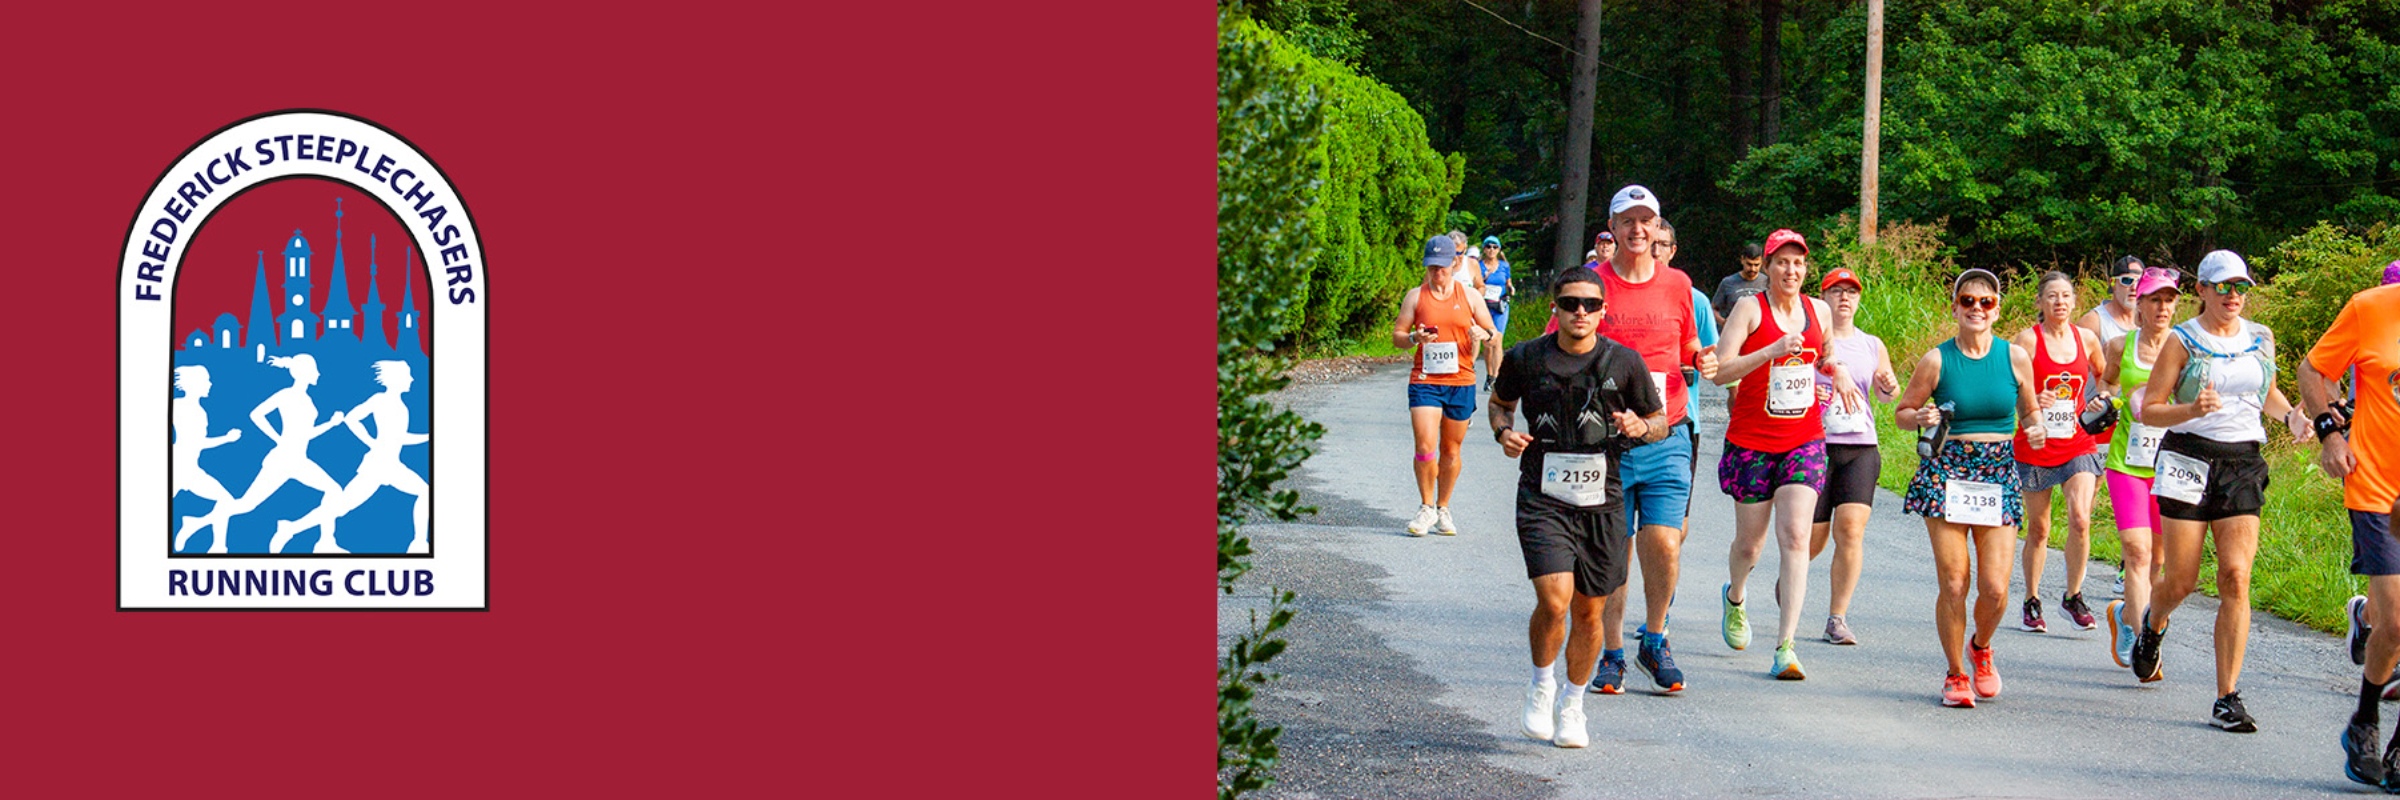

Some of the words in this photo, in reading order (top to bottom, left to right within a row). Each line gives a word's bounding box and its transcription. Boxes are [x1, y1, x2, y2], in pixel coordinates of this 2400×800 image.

[1613, 312, 1643, 325] More
[1432, 351, 1454, 360] 2101
[1785, 378, 1811, 390] 2091
[1562, 469, 1601, 483] 2159
[2168, 466, 2202, 485] 2098
[1963, 494, 1996, 507] 2138
